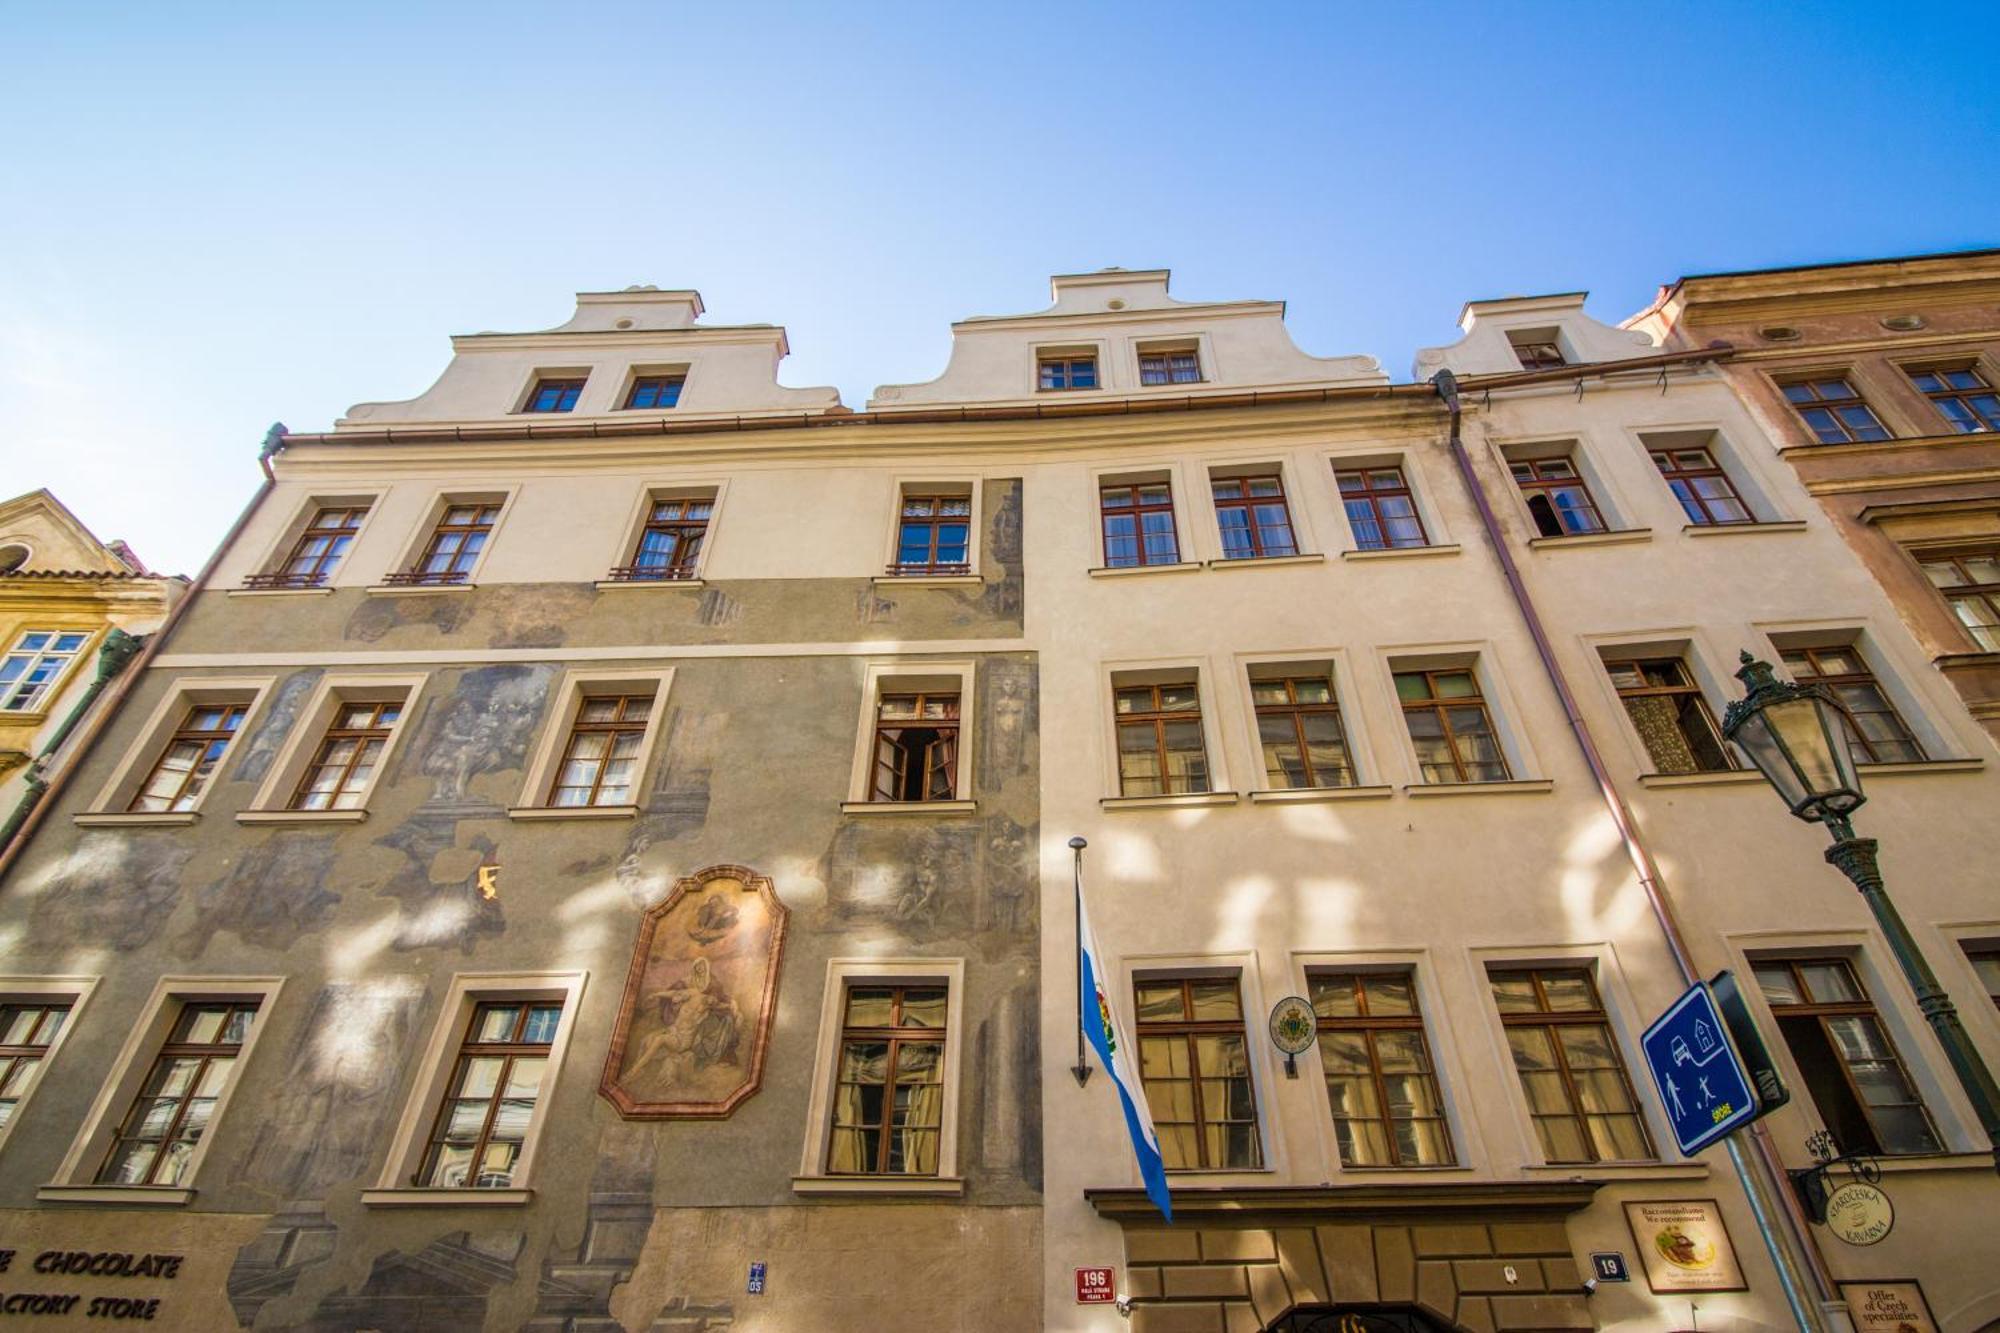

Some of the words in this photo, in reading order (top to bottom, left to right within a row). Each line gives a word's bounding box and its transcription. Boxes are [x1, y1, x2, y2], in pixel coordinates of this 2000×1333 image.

[1660, 1215, 1706, 1223] recommend
[1845, 1219, 1886, 1241] KAVÁRNA
[34, 1251, 184, 1279] CHOCOLATE
[1601, 1259, 1617, 1275] 19
[1084, 1271, 1105, 1286] 196
[1867, 1290, 1895, 1300] Offer
[0, 1293, 80, 1315] CTORY
[86, 1297, 160, 1320] STORE
[1865, 1301, 1876, 1311] of
[1876, 1300, 1908, 1312] Czech
